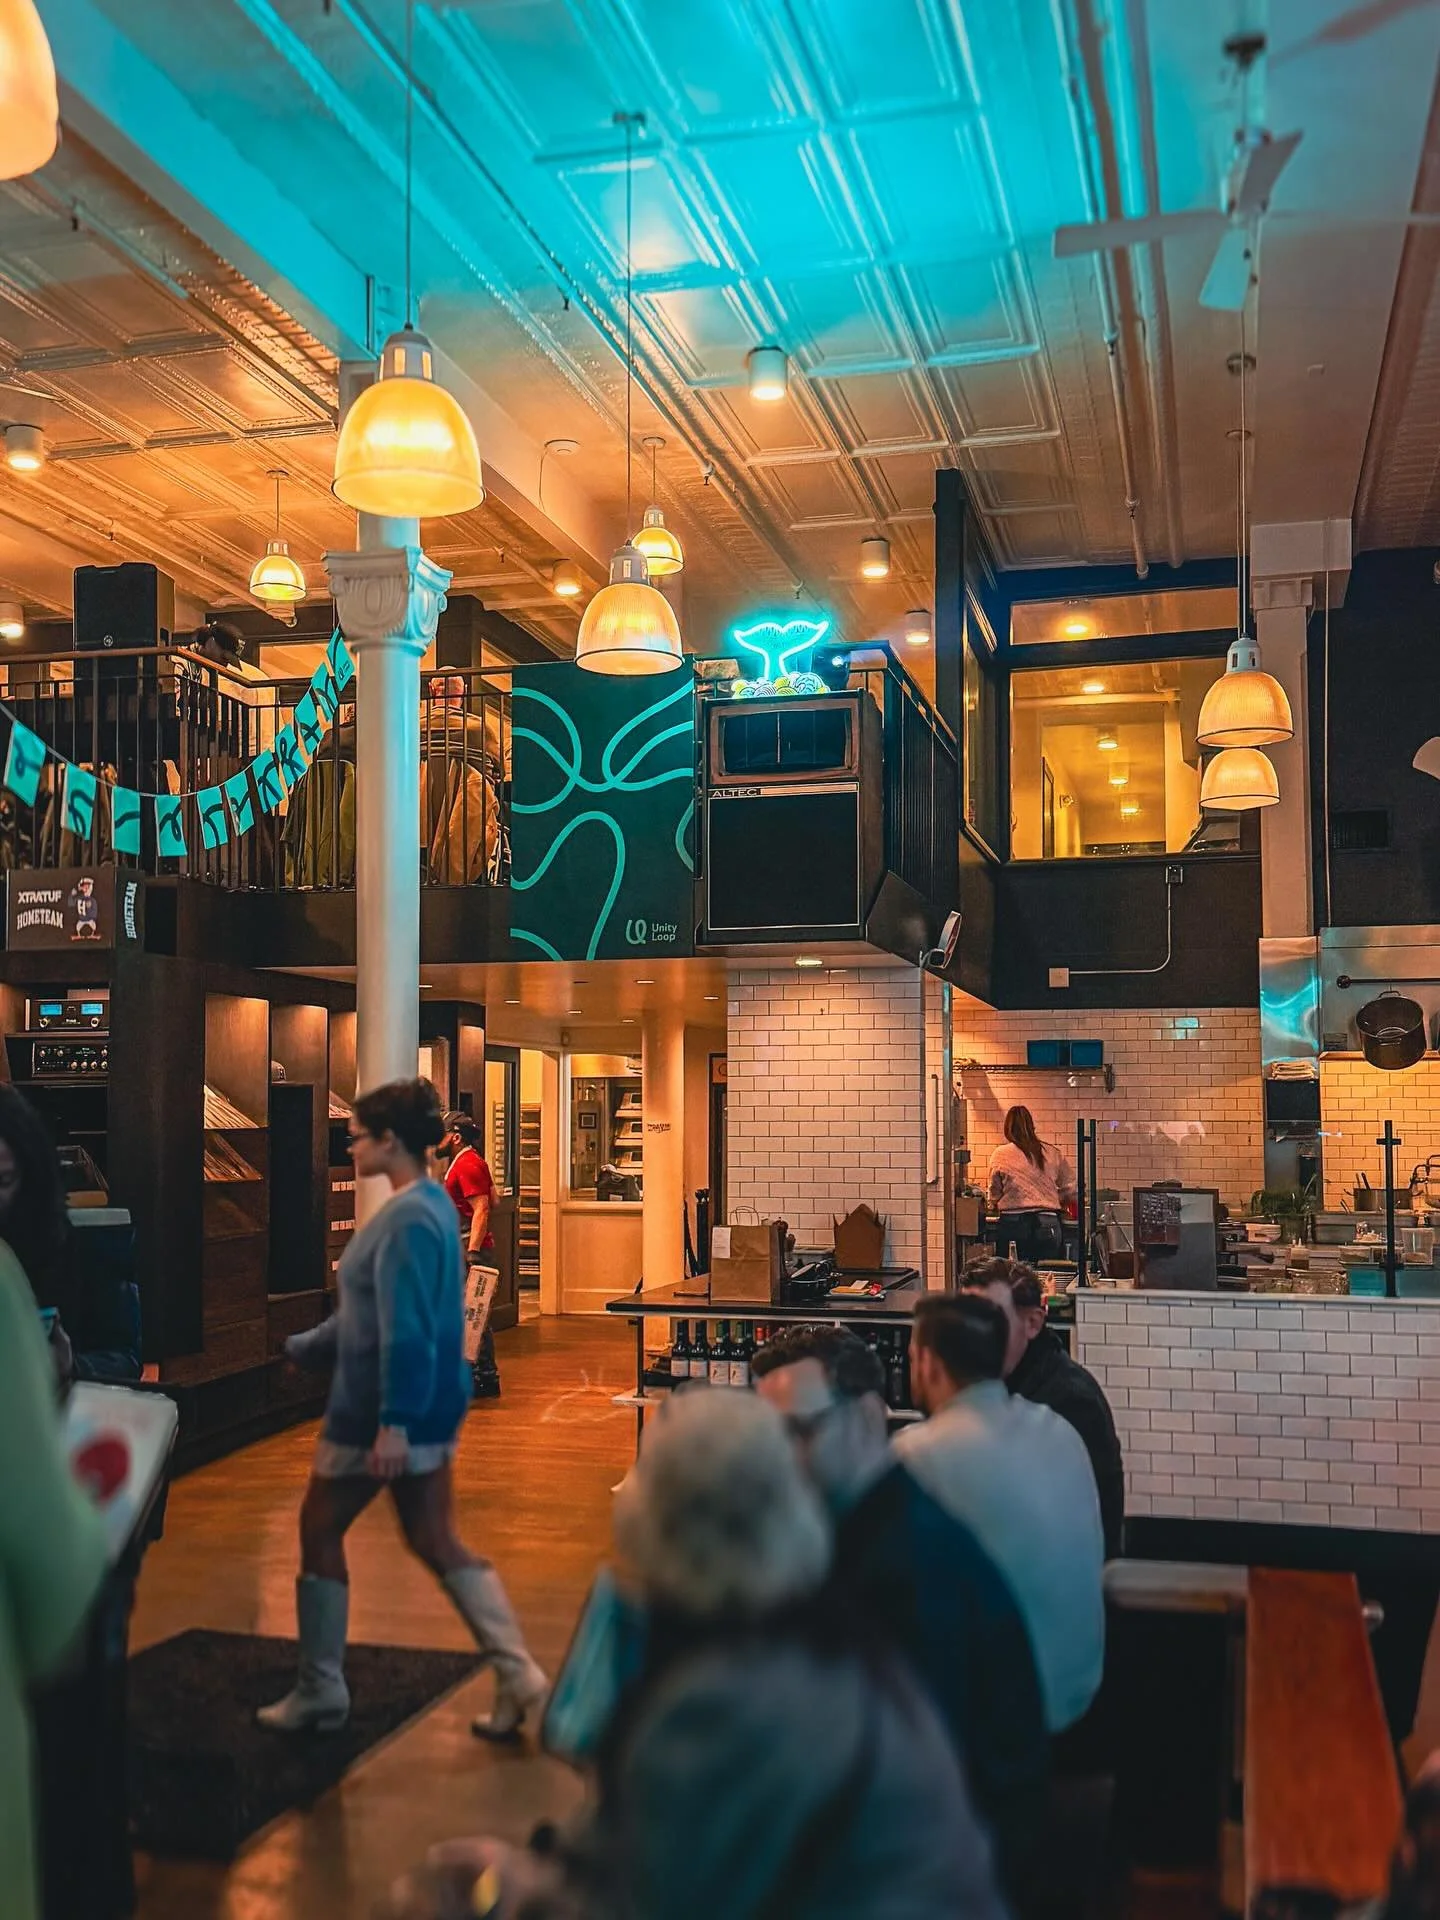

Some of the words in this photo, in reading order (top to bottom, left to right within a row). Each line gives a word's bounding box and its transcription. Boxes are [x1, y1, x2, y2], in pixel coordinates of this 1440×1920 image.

[712, 788, 757, 797] ALTEC
[18, 890, 62, 904] XTRATUF
[17, 908, 63, 930] HOMETEAM
[651, 922, 678, 934] Unity
[651, 932, 676, 943] Loop
